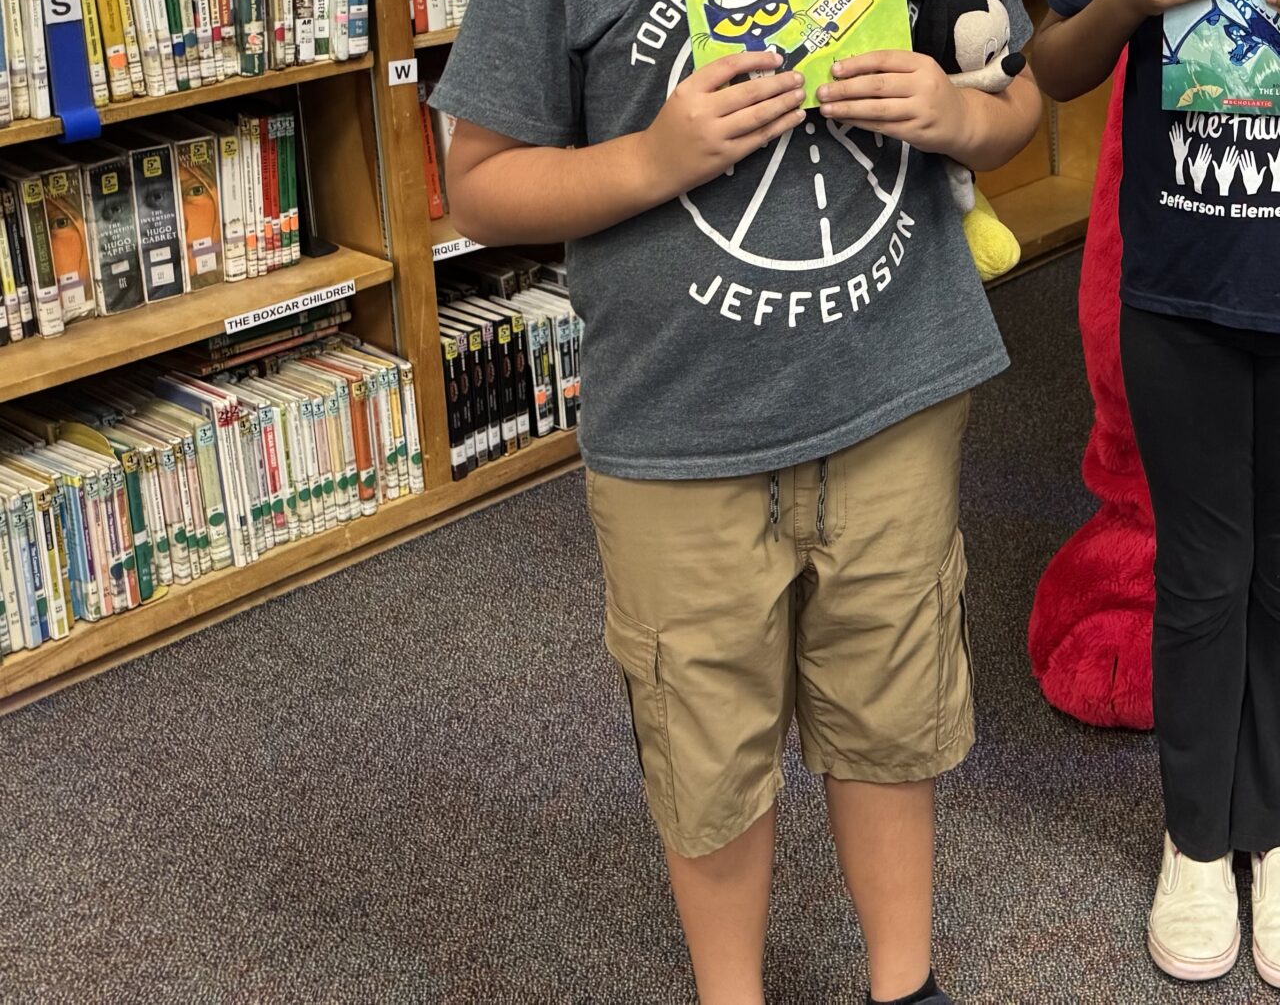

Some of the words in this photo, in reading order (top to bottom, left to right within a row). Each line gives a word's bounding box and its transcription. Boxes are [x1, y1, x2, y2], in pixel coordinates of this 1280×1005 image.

[394, 64, 411, 79] W
[1259, 88, 1274, 96] THE
[1228, 100, 1273, 108] SCHOLASTIC
[1159, 190, 1226, 217] Jefferson
[146, 225, 172, 237] HUGO
[104, 238, 131, 251] HUGO
[142, 232, 177, 244] CABRET
[688, 210, 916, 328] JEFFERSON
[227, 316, 250, 331] THE
[253, 299, 300, 323] BOXCAR
[302, 282, 355, 307] CHILDREN
